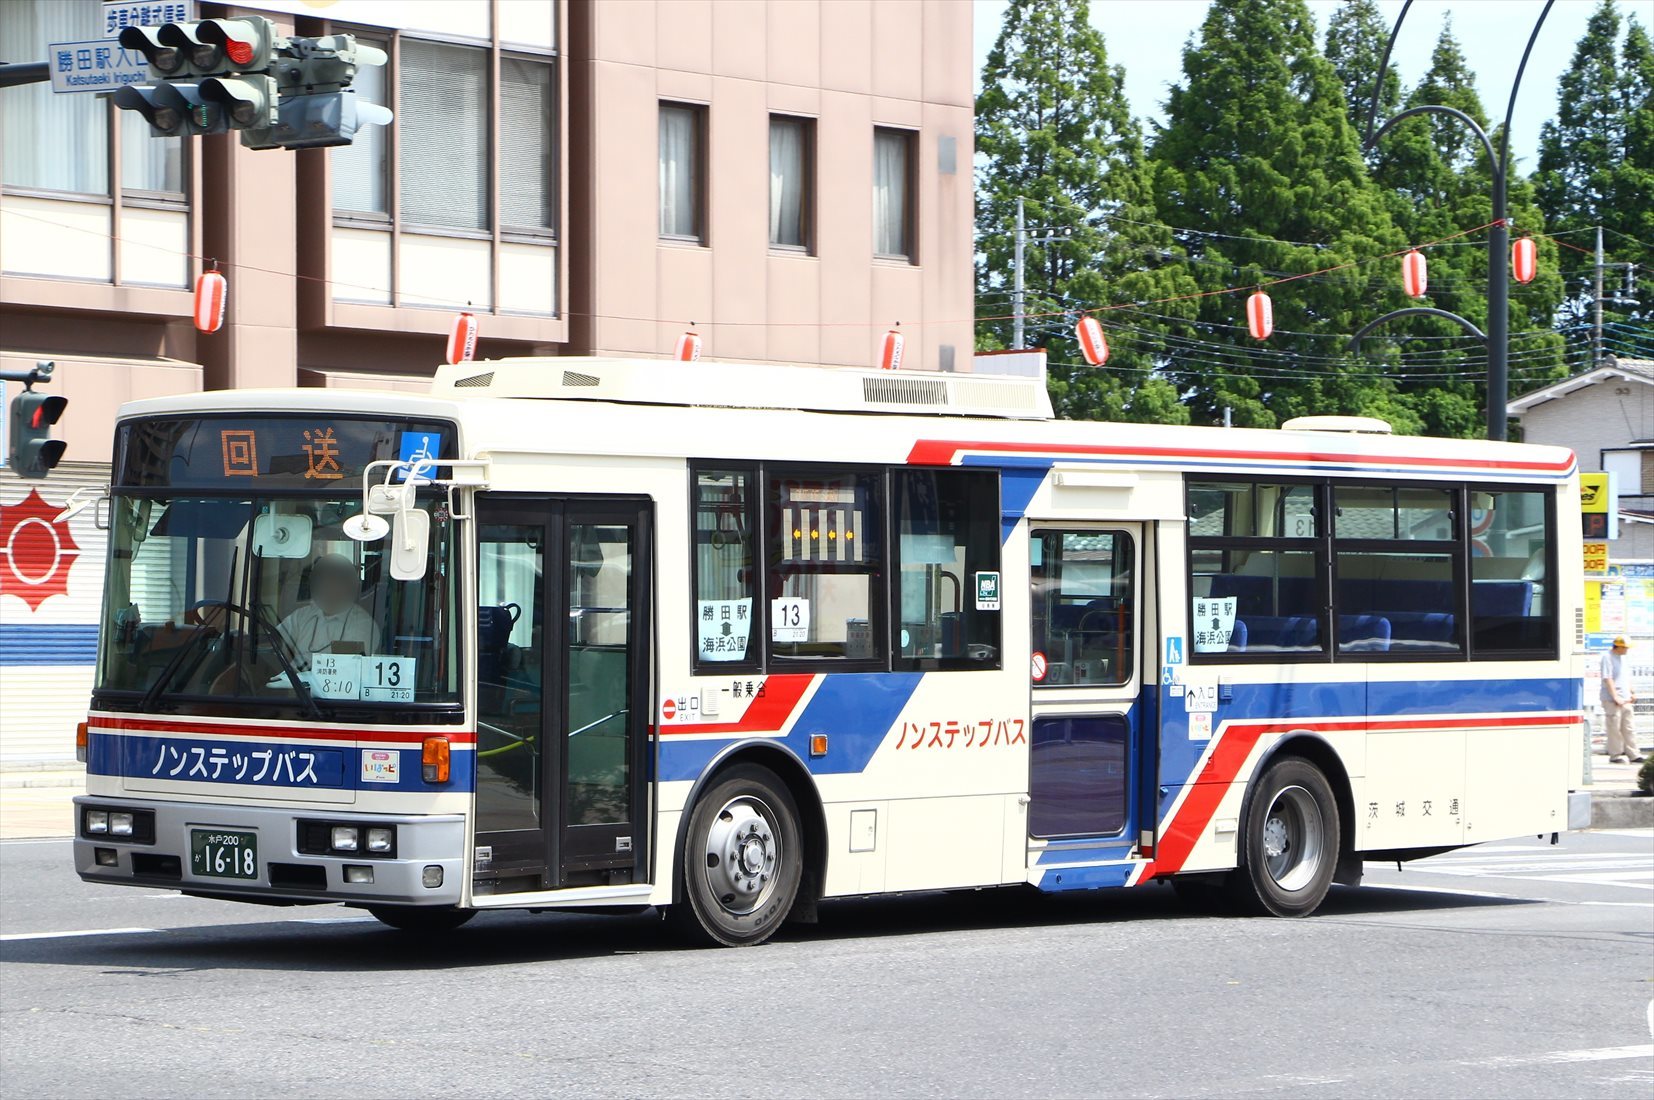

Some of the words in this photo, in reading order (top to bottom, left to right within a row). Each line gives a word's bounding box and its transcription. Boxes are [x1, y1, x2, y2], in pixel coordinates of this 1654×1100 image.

[66, 72, 111, 86] Katsutaeki
[114, 70, 147, 84] Iriguchi
[221, 427, 344, 479] 回送
[703, 605, 747, 621] 勝田駅
[782, 605, 800, 626] 13
[1197, 603, 1233, 617] 勝田駅
[703, 636, 747, 653] 海浜公園
[375, 662, 401, 687] 13
[322, 679, 353, 694] 8:10
[364, 688, 370, 697] B
[721, 681, 767, 698] 一般乗合
[1198, 686, 1215, 699] 入口
[678, 696, 699, 711] 出口
[680, 713, 696, 722] EXIT
[896, 718, 1026, 750] ノンステップバス
[152, 744, 318, 784] ノンステップバス
[1368, 798, 1460, 818] 茨城交通
[208, 834, 239, 846] 水戸200
[205, 845, 254, 875] 16-18
